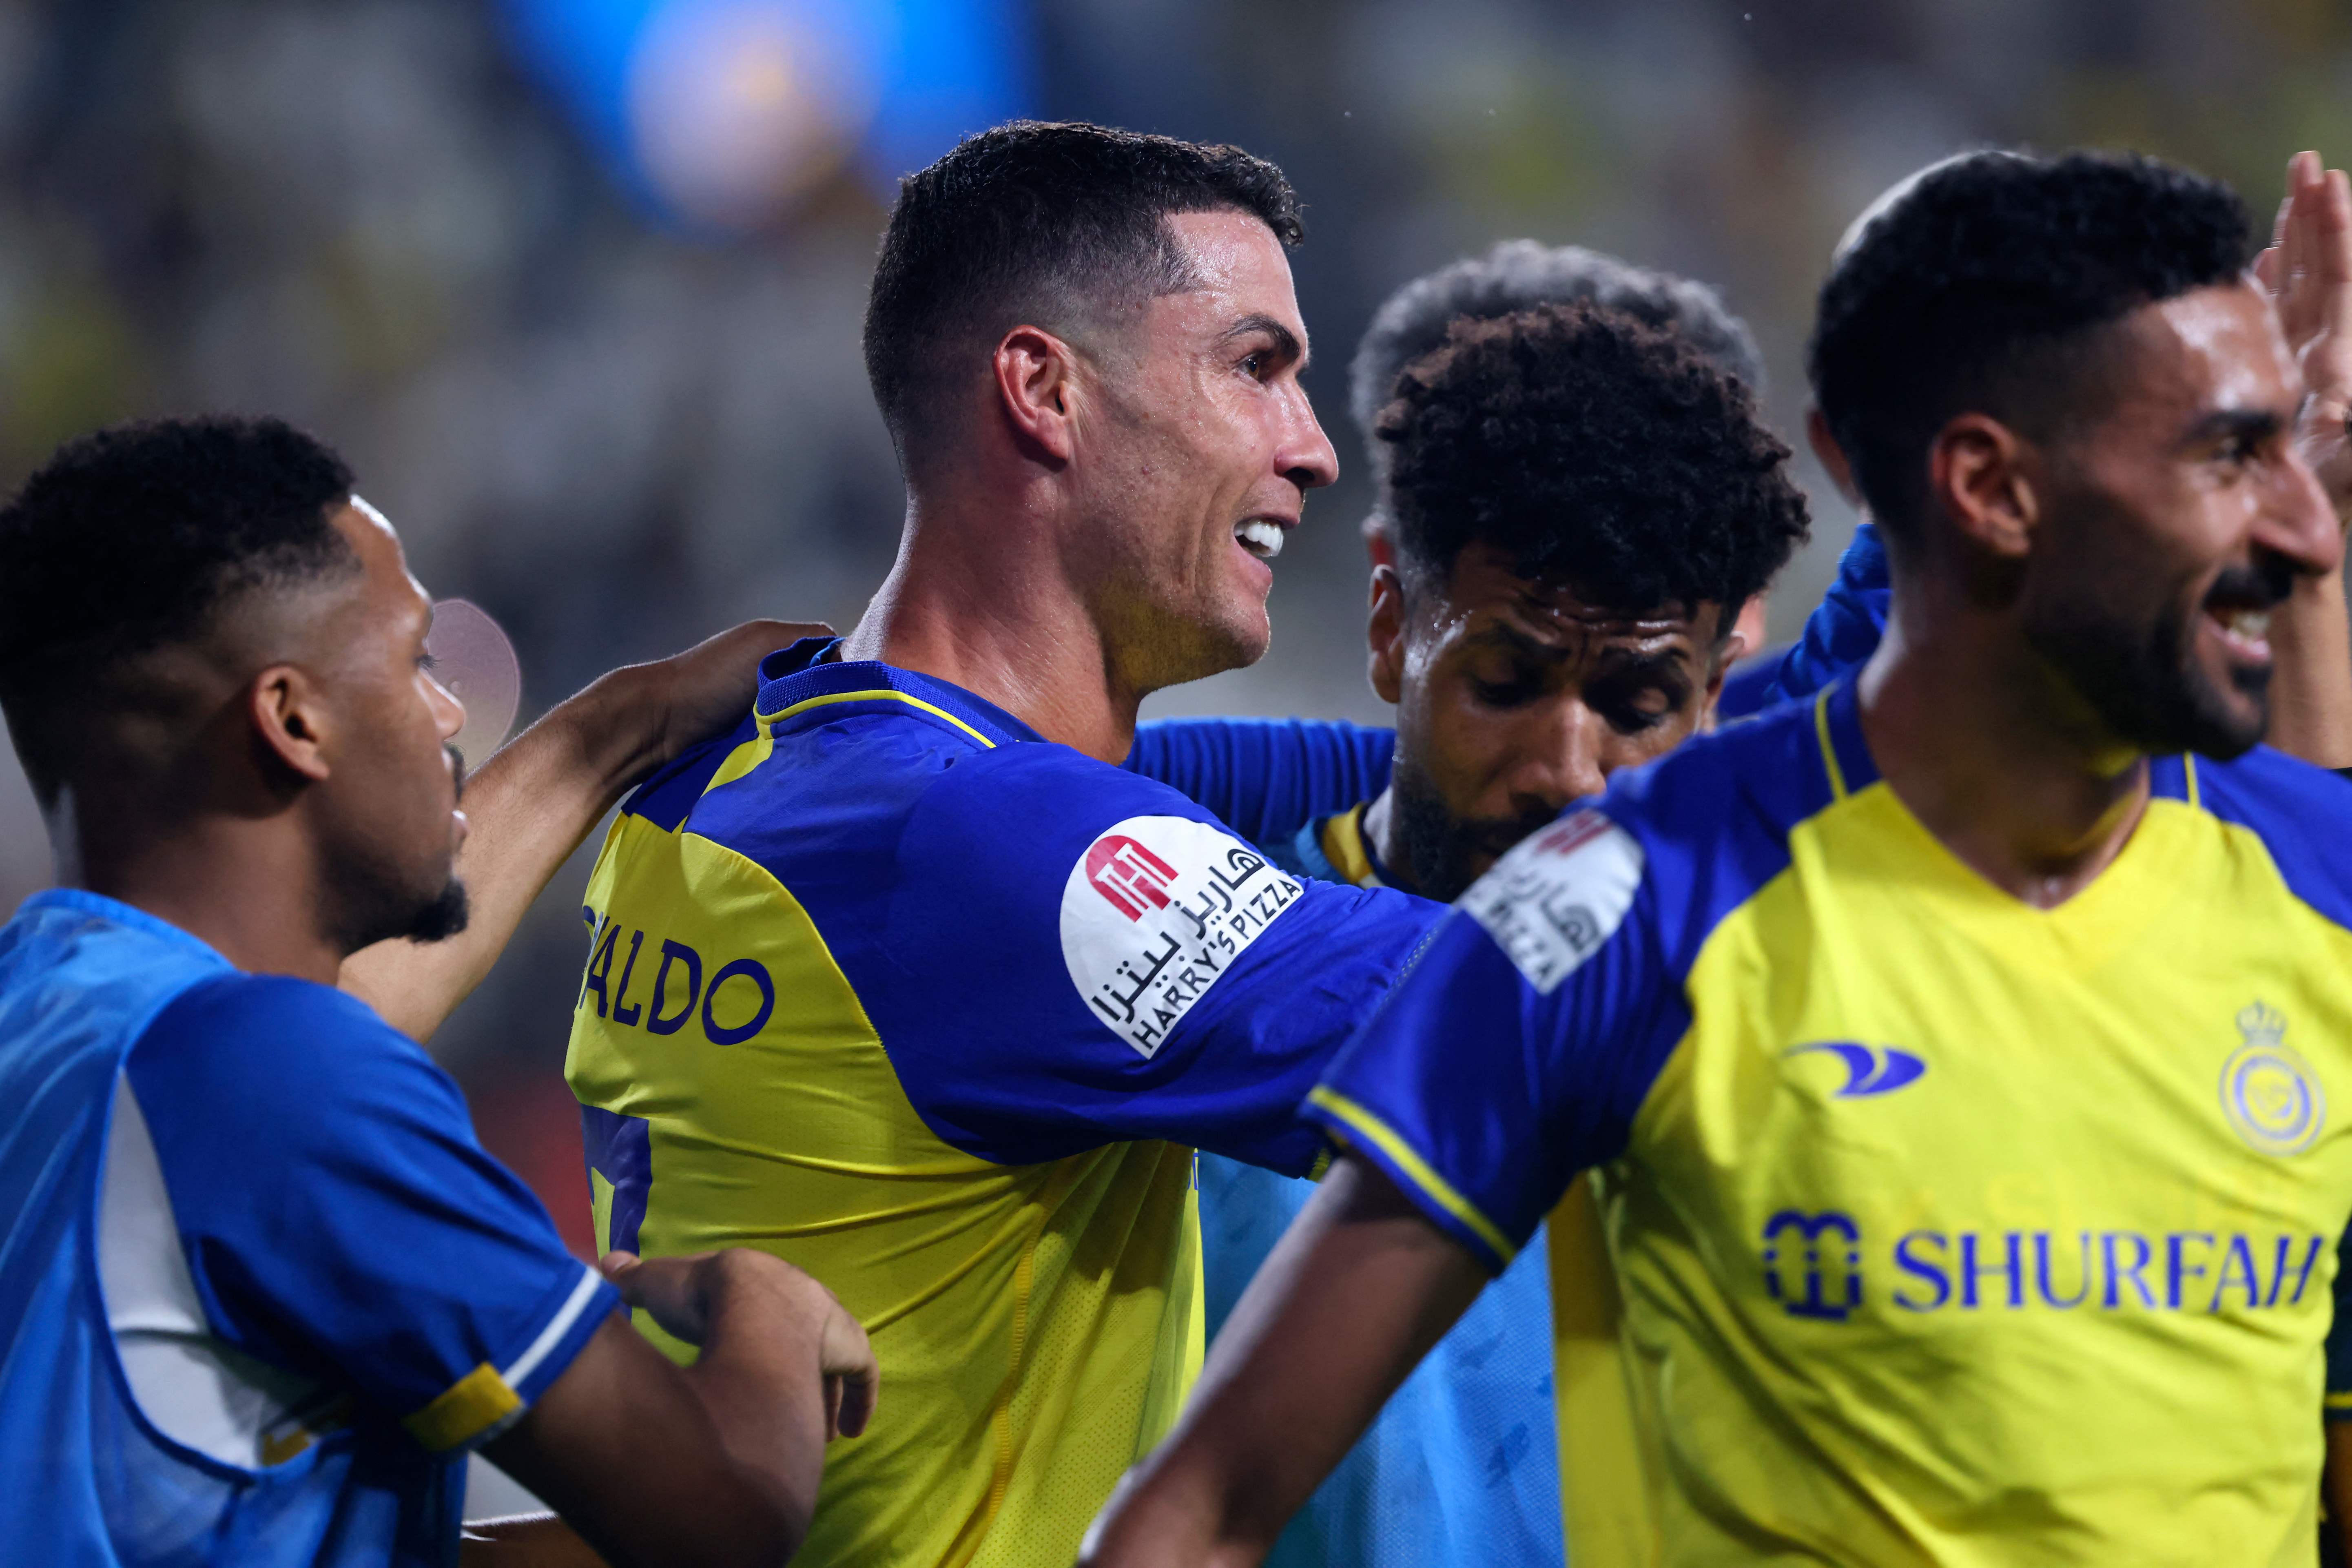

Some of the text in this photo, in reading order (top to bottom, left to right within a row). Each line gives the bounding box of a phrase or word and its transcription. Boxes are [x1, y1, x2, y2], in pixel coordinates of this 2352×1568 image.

[580, 904, 775, 1046] ALDO
[1132, 879, 1301, 1050] HARRY'S PIZZA
[1892, 1231, 2325, 1313] SHURFAH
